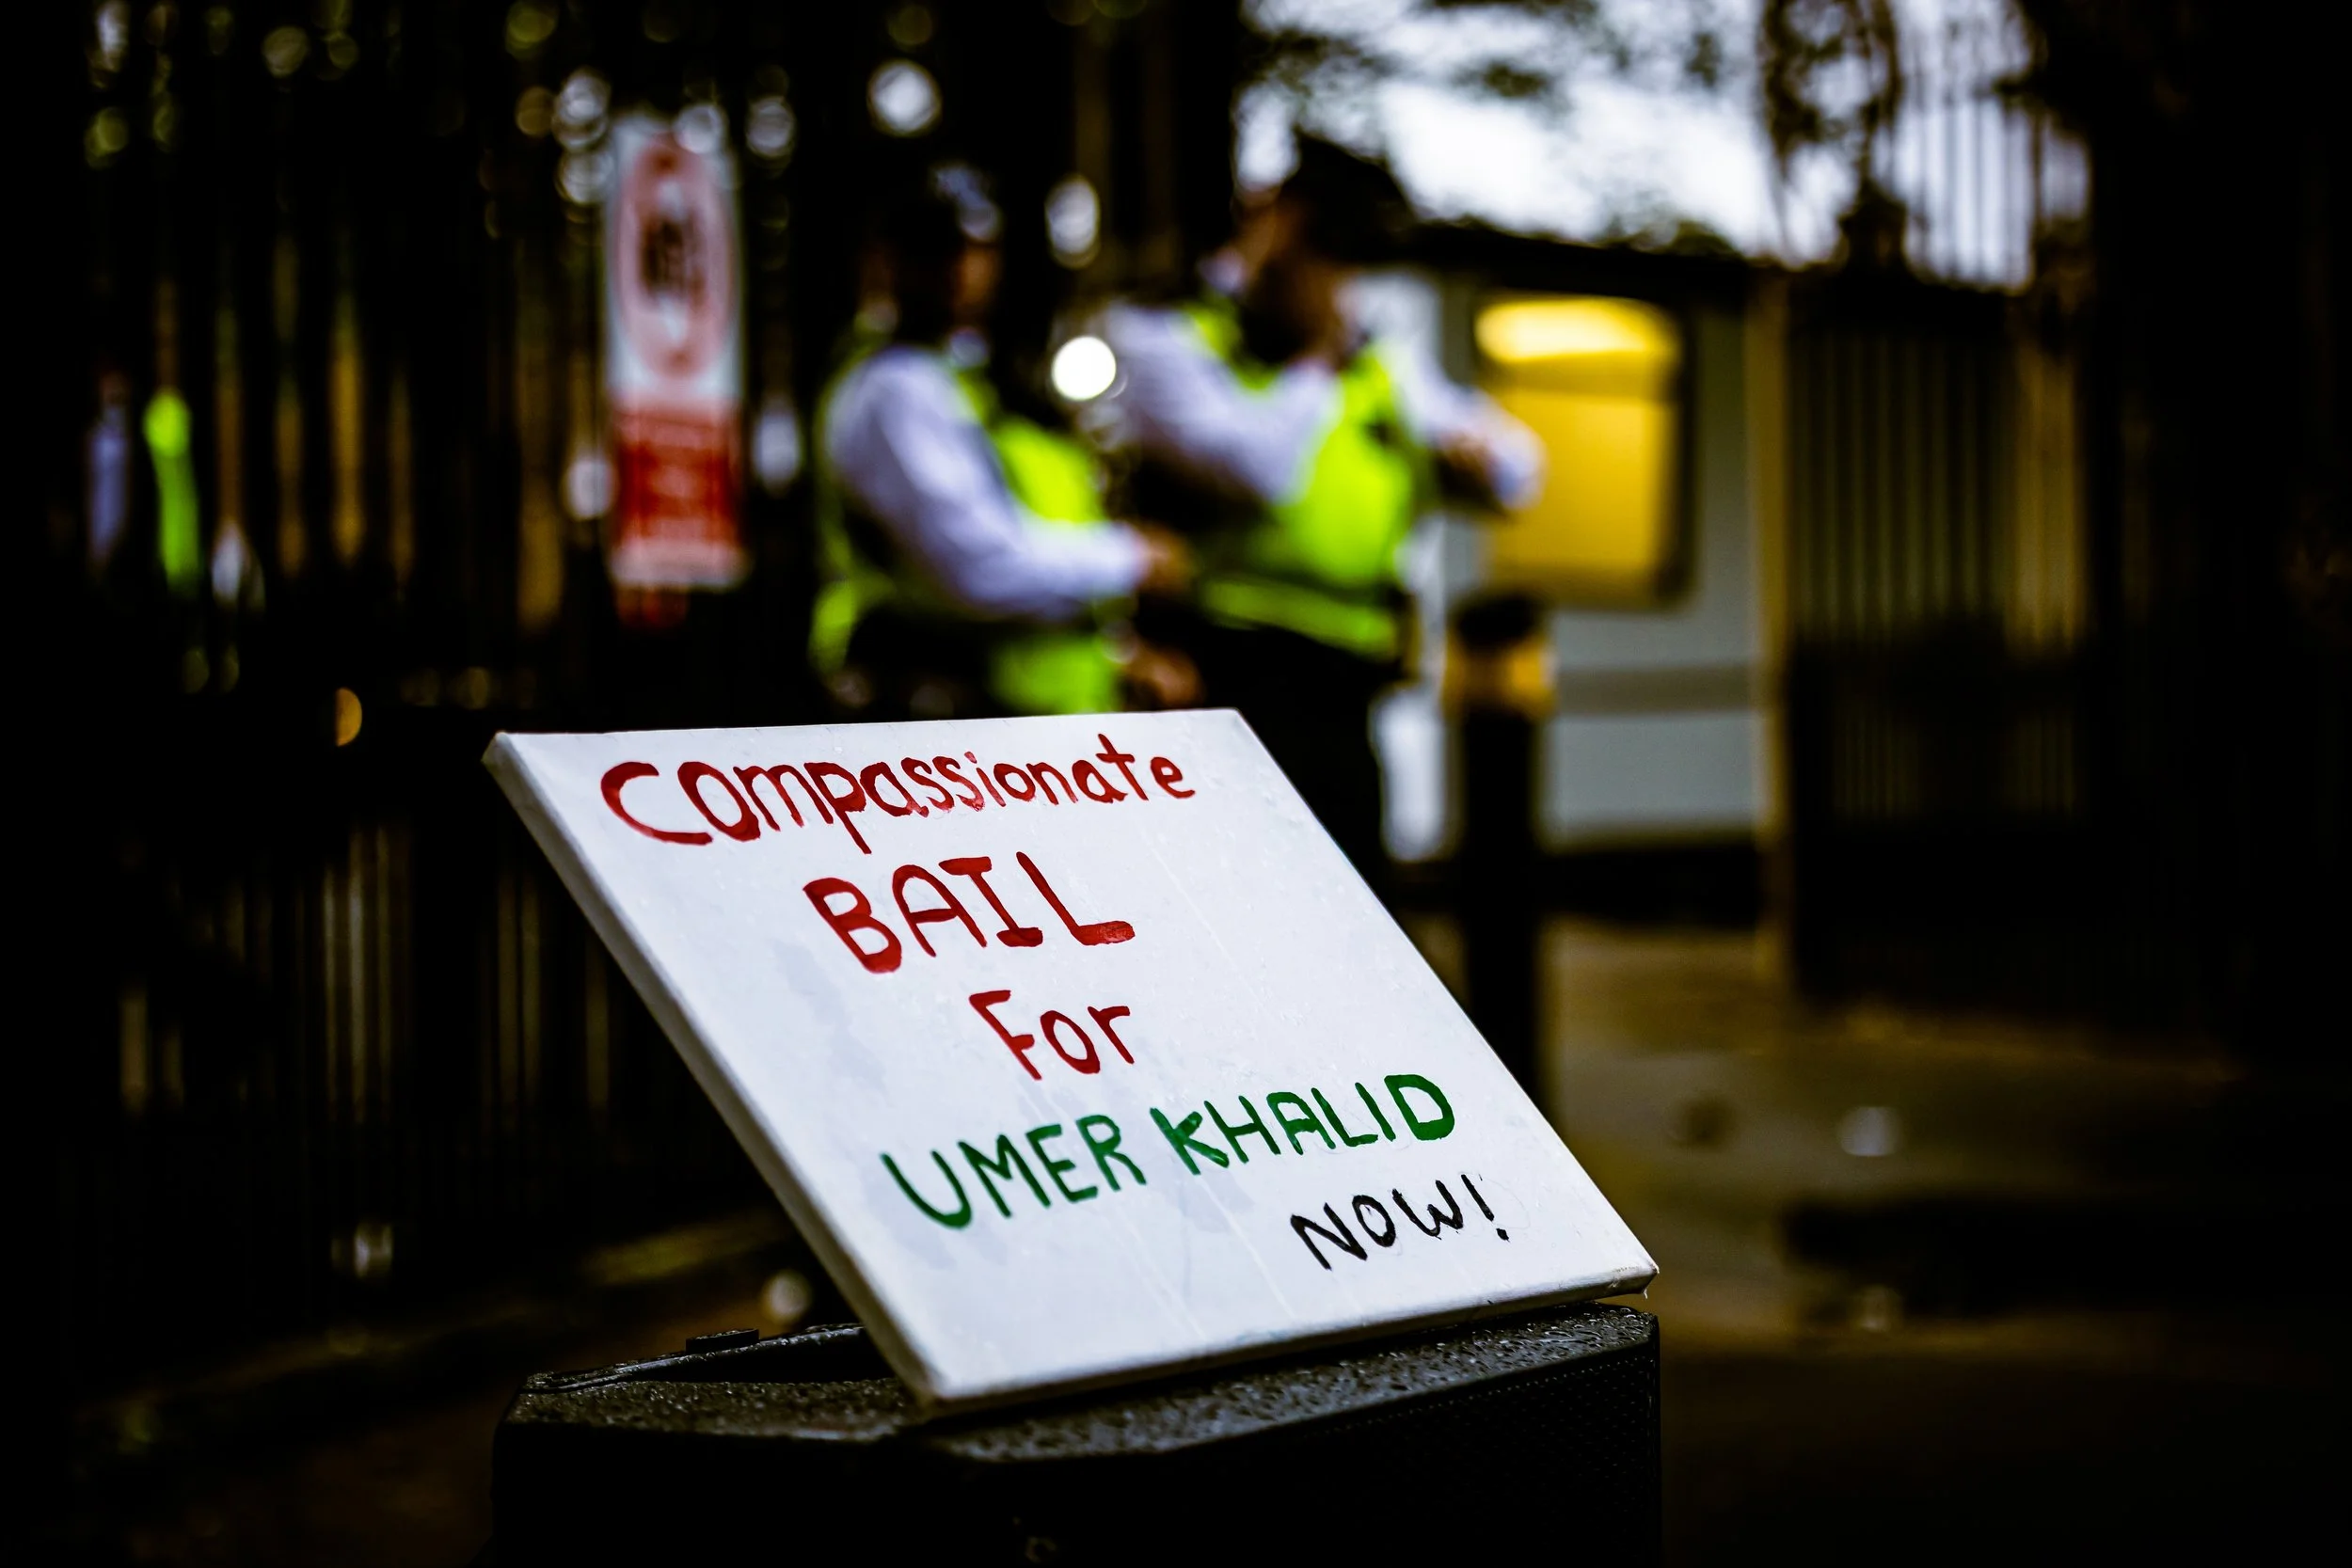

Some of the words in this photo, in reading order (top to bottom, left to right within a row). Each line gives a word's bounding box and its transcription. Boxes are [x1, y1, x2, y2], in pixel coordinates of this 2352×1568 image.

[801, 850, 1136, 974] BAIL
[967, 989, 1136, 1081] For
[879, 1113, 1148, 1230] UMER
[1148, 1072, 1456, 1176] KHALID
[1289, 1173, 1511, 1271] NOW!
